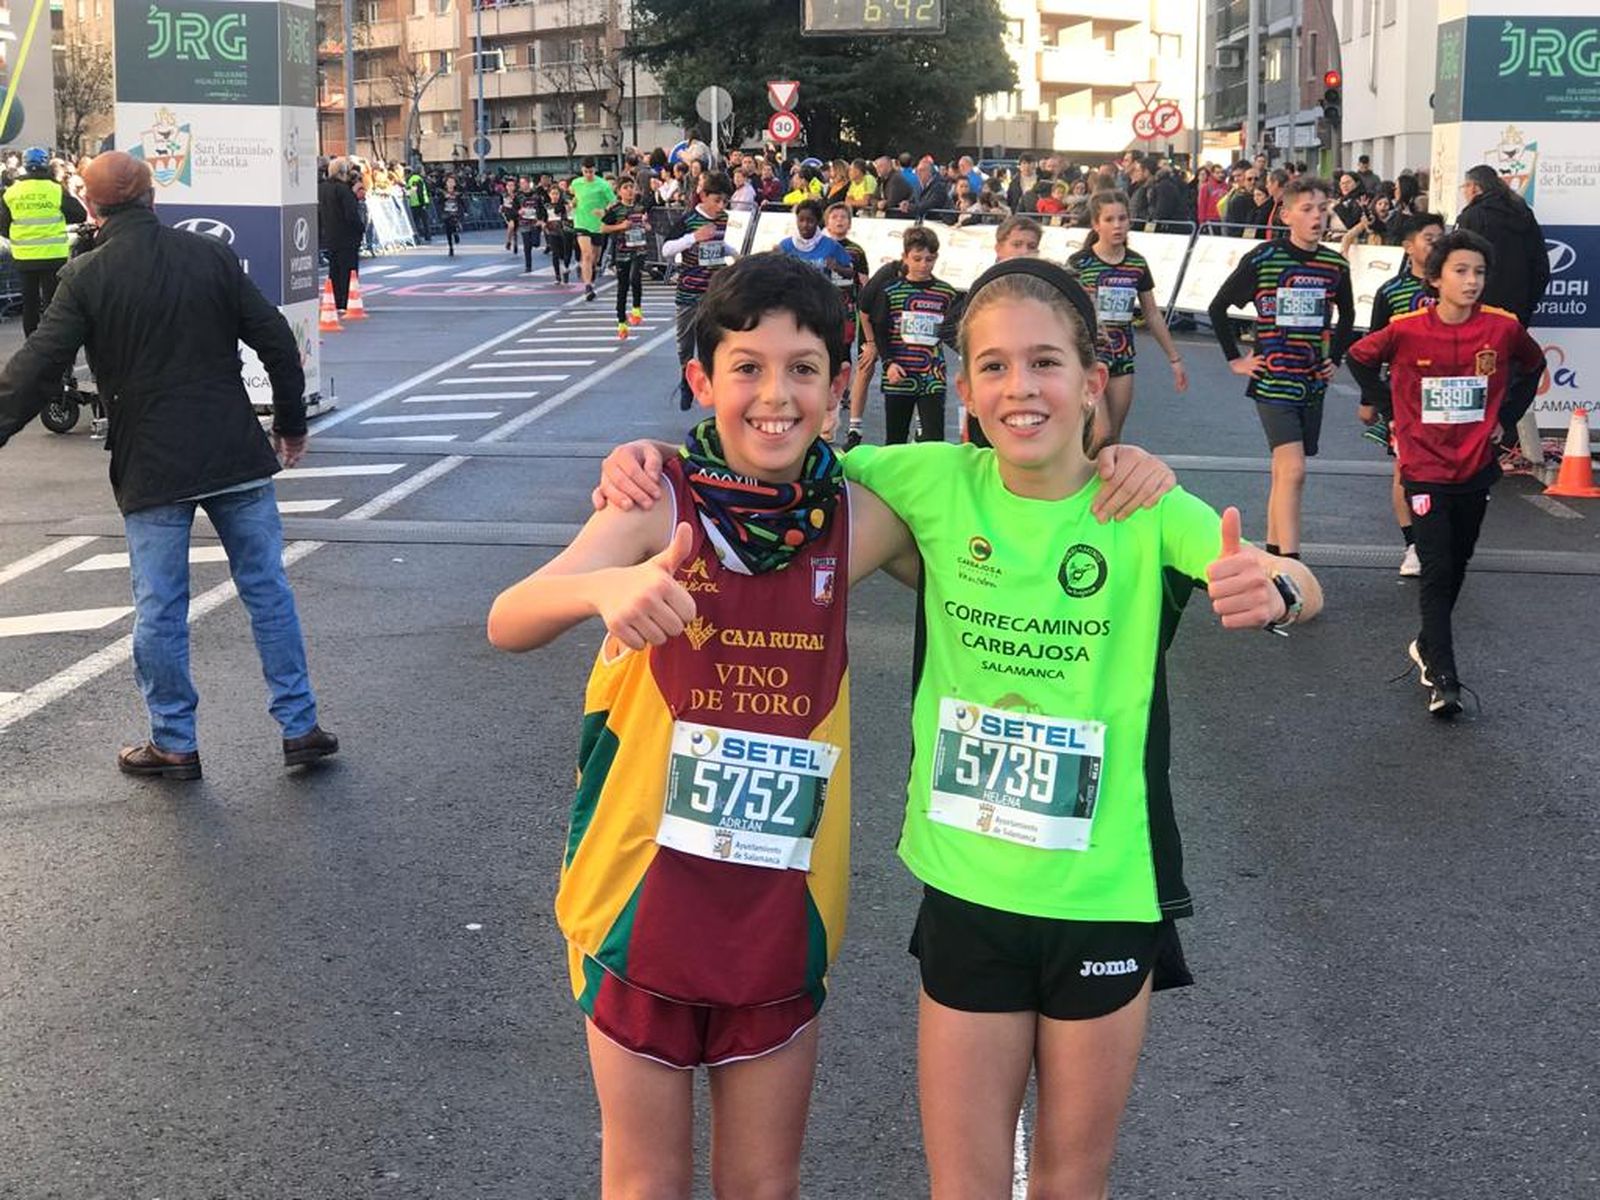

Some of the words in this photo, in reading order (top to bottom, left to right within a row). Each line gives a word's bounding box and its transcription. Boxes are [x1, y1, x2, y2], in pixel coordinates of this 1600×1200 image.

[147, 5, 247, 61] JRG
[1499, 21, 1600, 77] JRG
[775, 122, 792, 132] 30
[195, 143, 215, 155] San
[219, 143, 274, 156] Estanislao
[195, 156, 206, 167] de
[211, 156, 249, 167] Kostka
[1539, 162, 1561, 173] San
[1539, 174, 1554, 186] de
[1557, 174, 1596, 187] Kostka
[1533, 299, 1587, 315] orauto
[1430, 389, 1473, 407] 5890
[1532, 400, 1600, 412] LAMANCA
[944, 601, 1111, 636] CORRECAMINOS
[720, 629, 765, 648] CAJA
[769, 631, 824, 651] RURAL
[962, 631, 1090, 662] CARBAJOSA
[714, 663, 789, 688] VINO
[981, 661, 1065, 680] SALAMANCA
[690, 689, 723, 711] DE
[731, 691, 811, 717] TORO
[981, 714, 1086, 749] SETEL
[721, 737, 820, 771] SETEL
[955, 735, 1059, 804] 5739
[690, 760, 801, 826] 5752
[983, 790, 1023, 809] HELENA
[996, 815, 1038, 832] Ayuntamiento
[1003, 827, 1037, 843] Salamanca
[735, 841, 782, 855] Ayuntamiento
[734, 852, 742, 860] de
[744, 852, 781, 864] Salamanca
